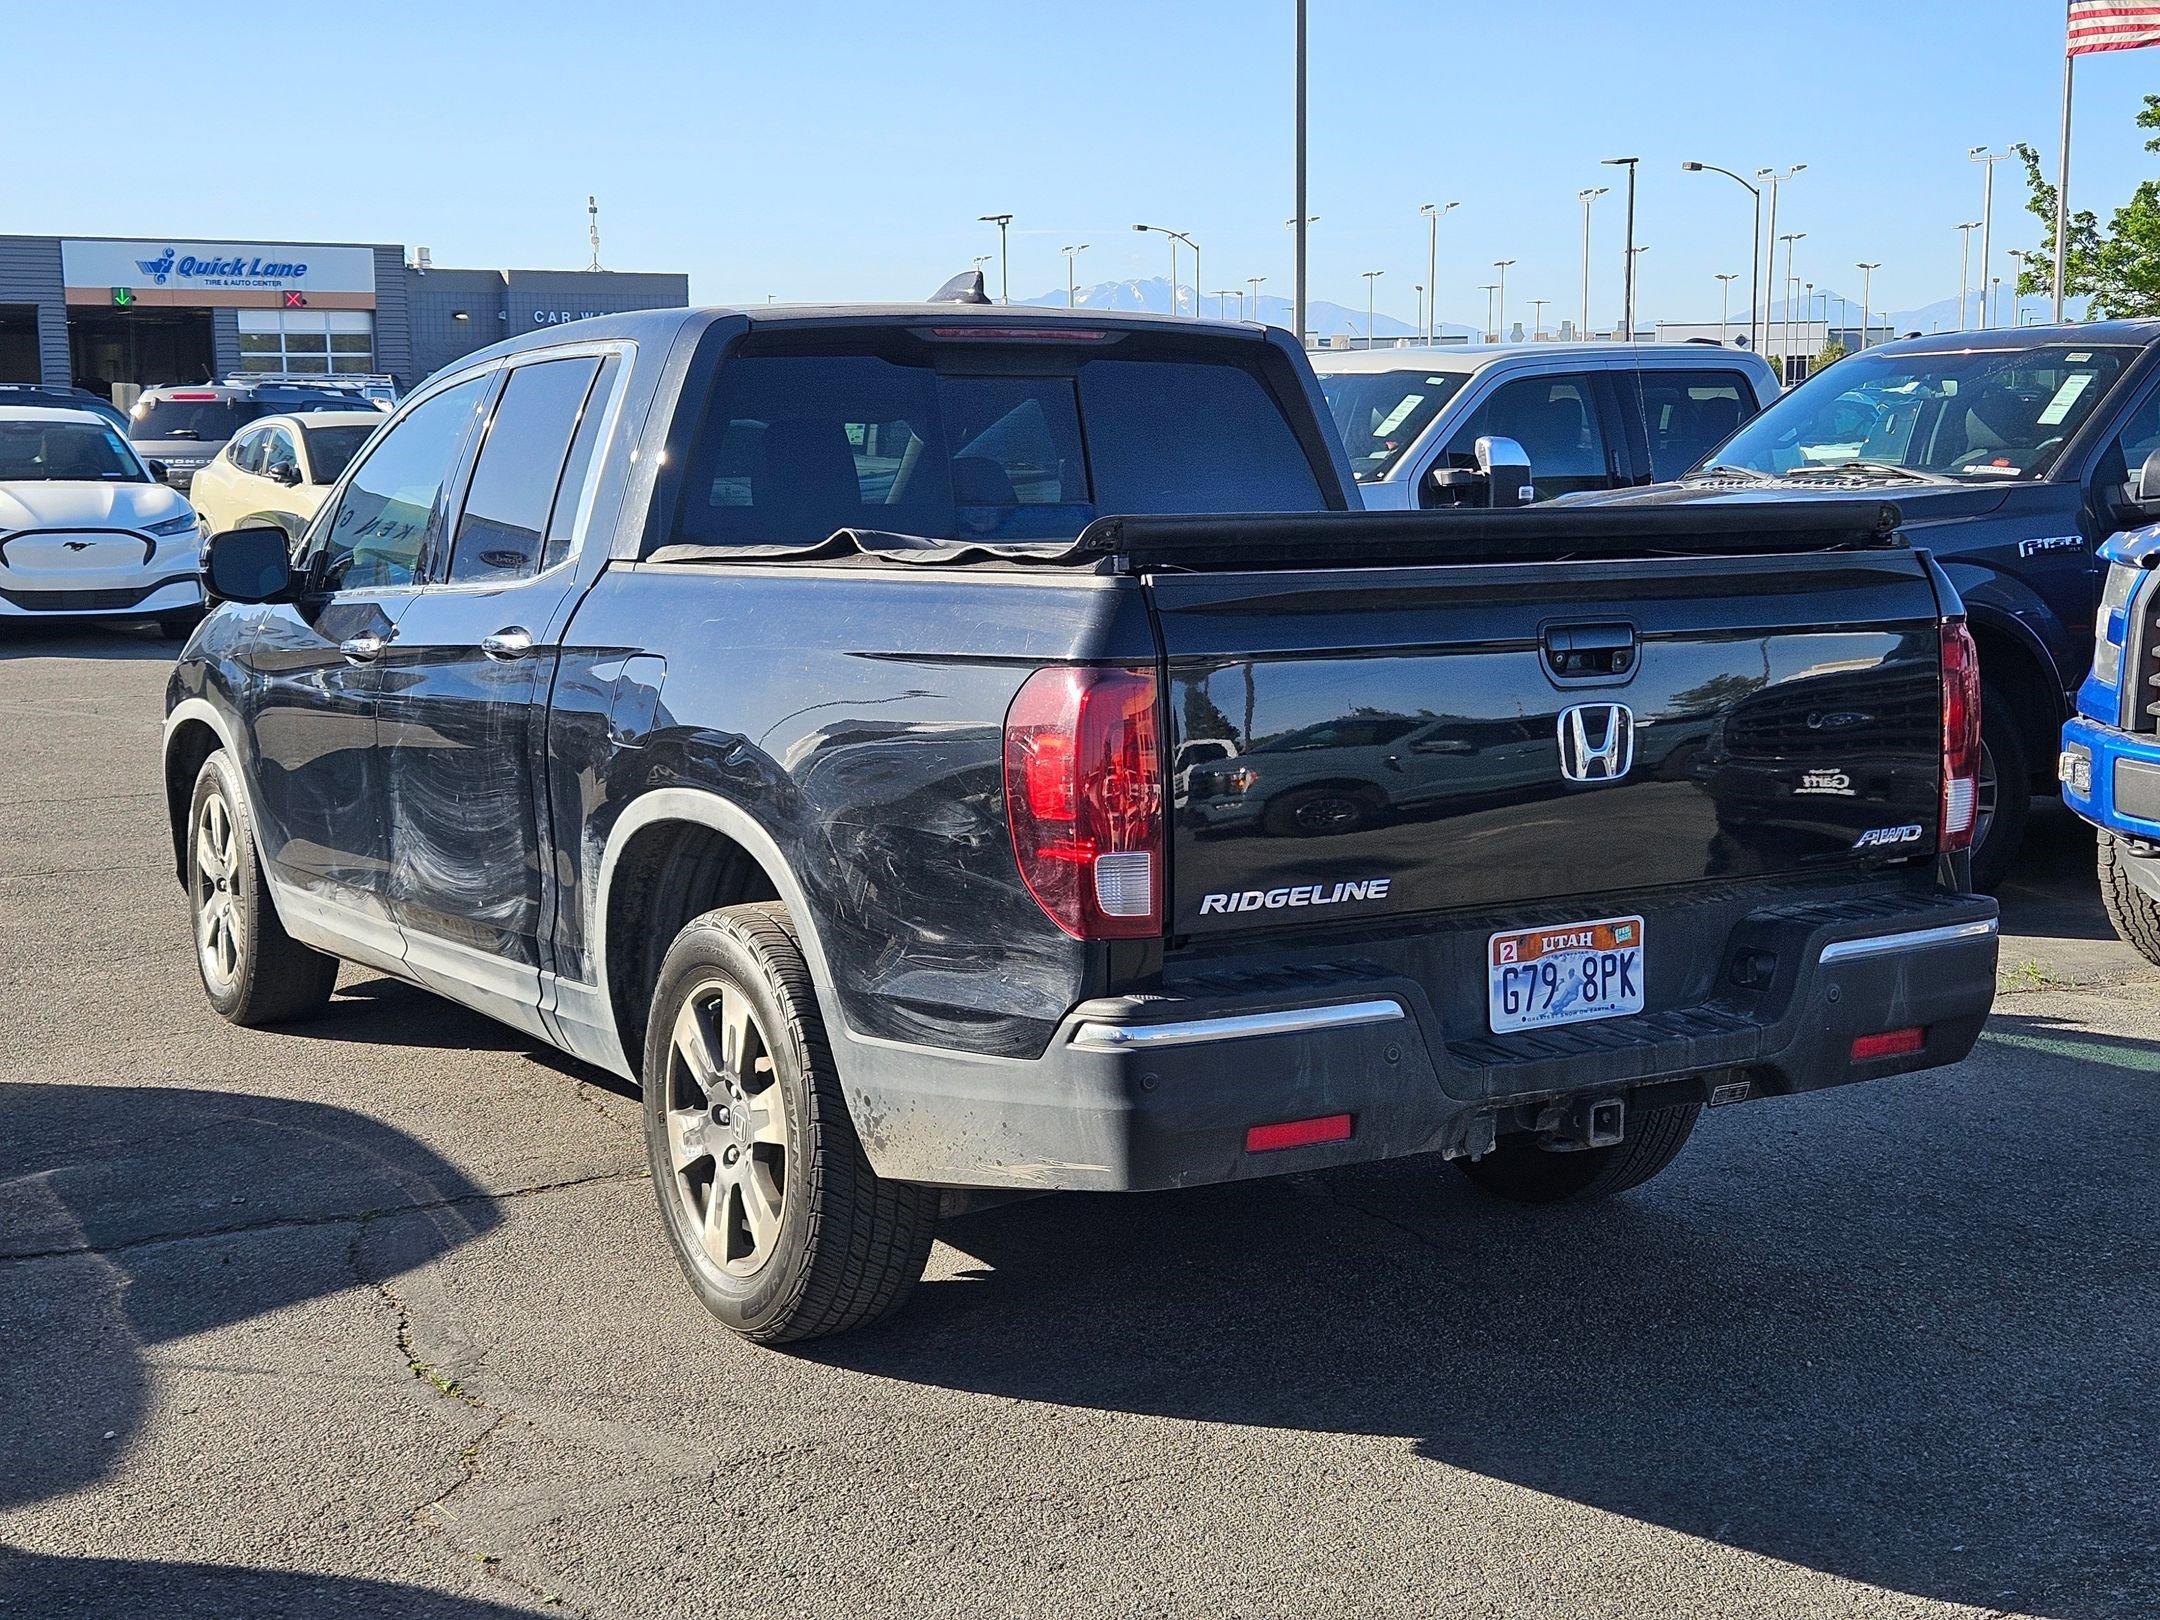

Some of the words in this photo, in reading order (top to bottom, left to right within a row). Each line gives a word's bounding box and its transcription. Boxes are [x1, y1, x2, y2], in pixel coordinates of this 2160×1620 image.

[178, 256, 247, 277] Quick
[248, 258, 307, 277] Lane
[534, 311, 571, 323] CAR
[1852, 824, 1922, 848] AWD
[1199, 879, 1391, 915] RIDGELINE
[1503, 944, 1514, 961] 2
[1541, 931, 1593, 952] UTAH
[1502, 962, 1558, 1015] G79
[1582, 951, 1637, 1002] 8PK
